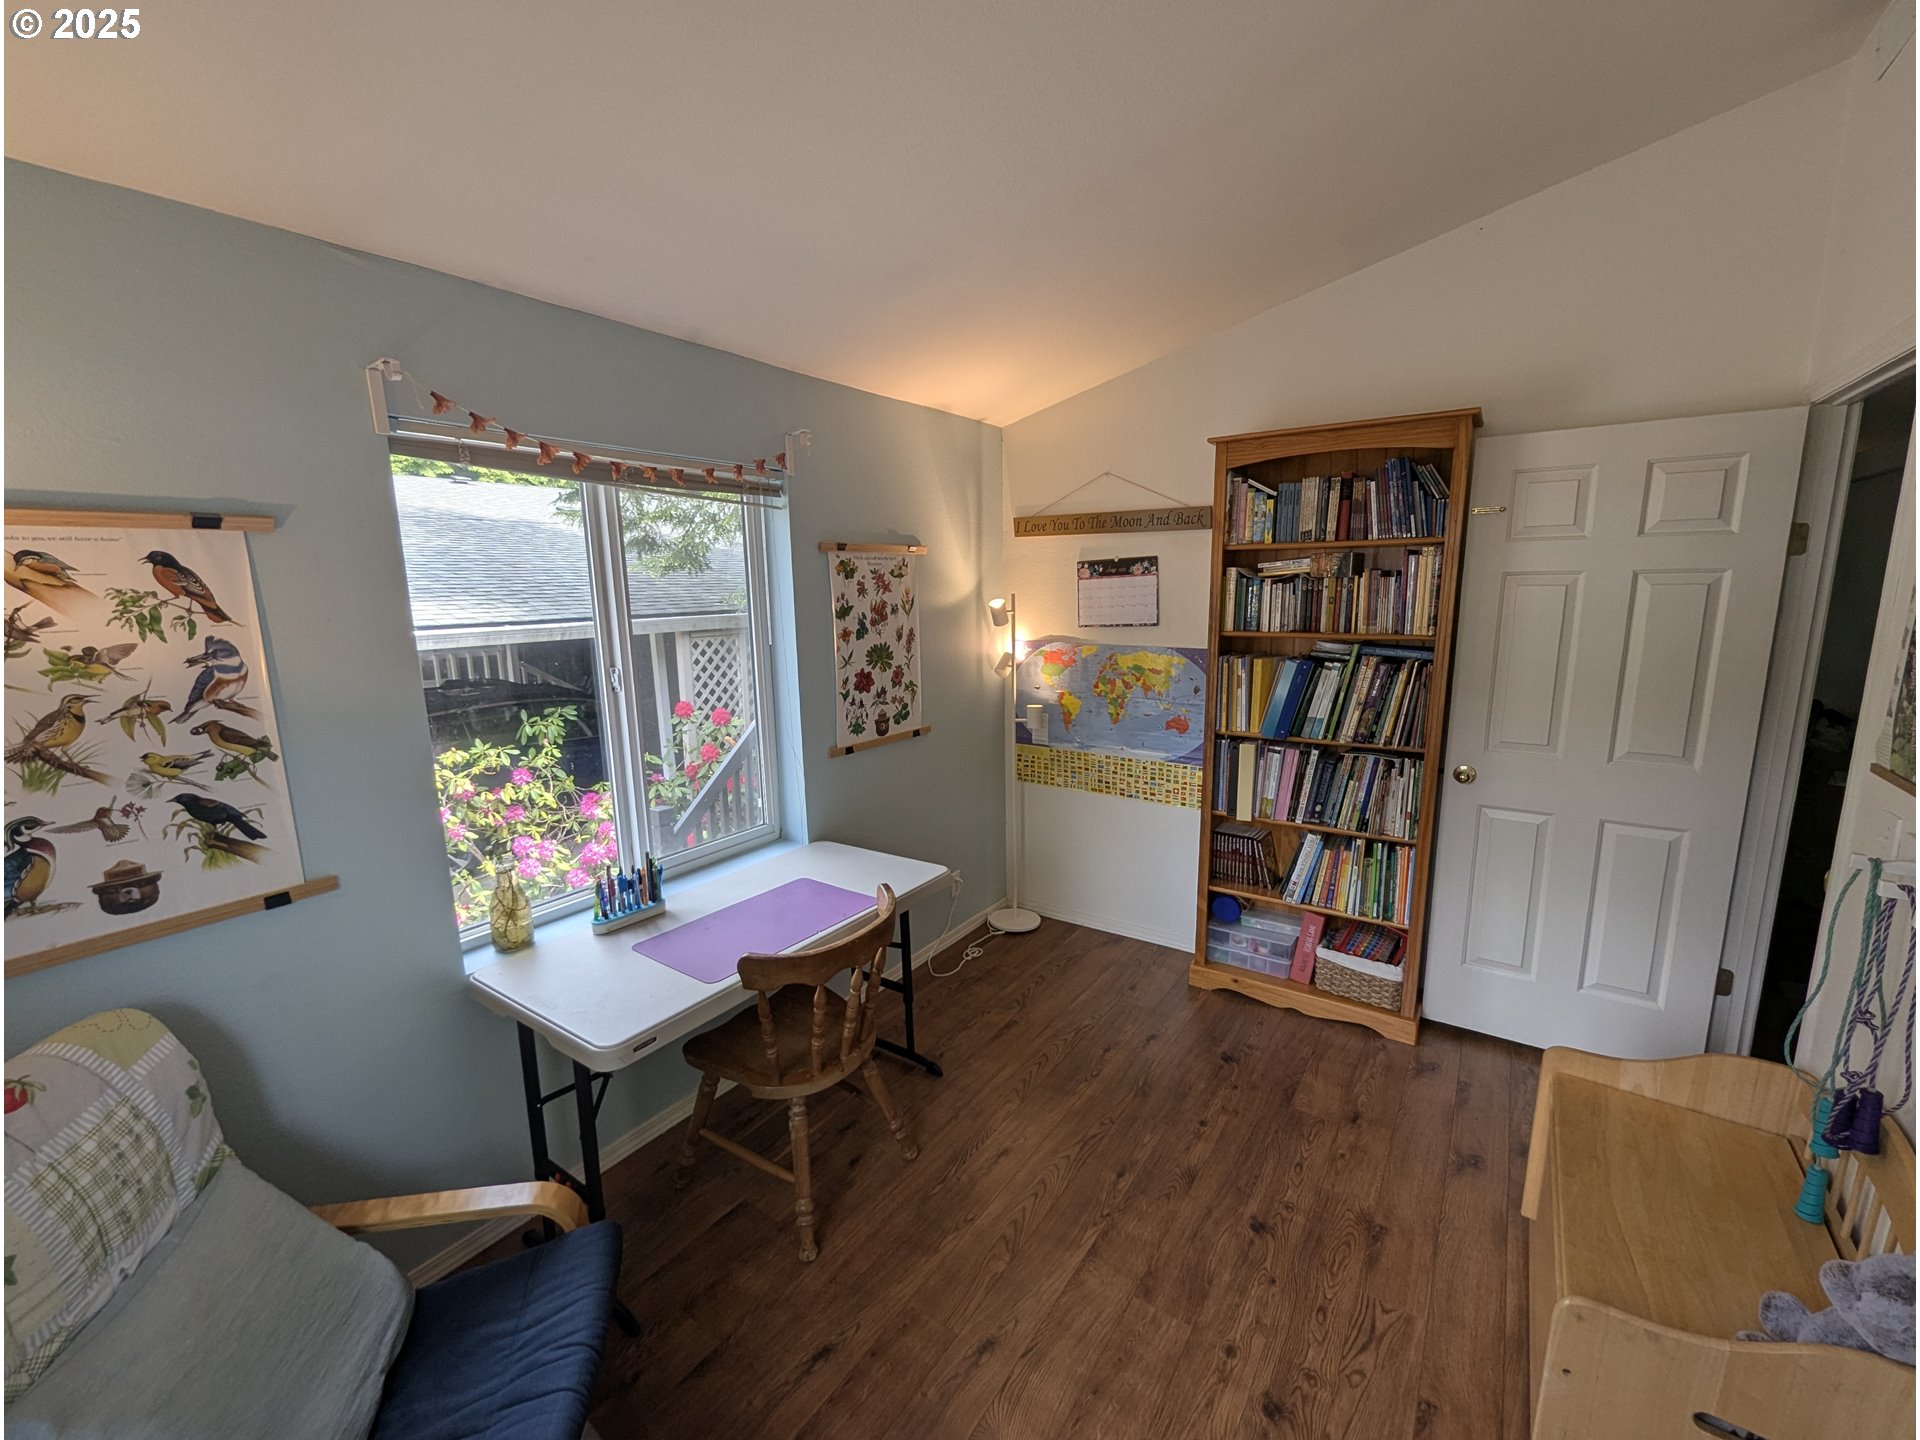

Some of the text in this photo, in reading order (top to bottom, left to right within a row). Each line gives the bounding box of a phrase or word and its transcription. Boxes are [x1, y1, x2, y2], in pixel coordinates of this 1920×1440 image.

[1015, 509, 1207, 533] I Love You To The Moon And Back
